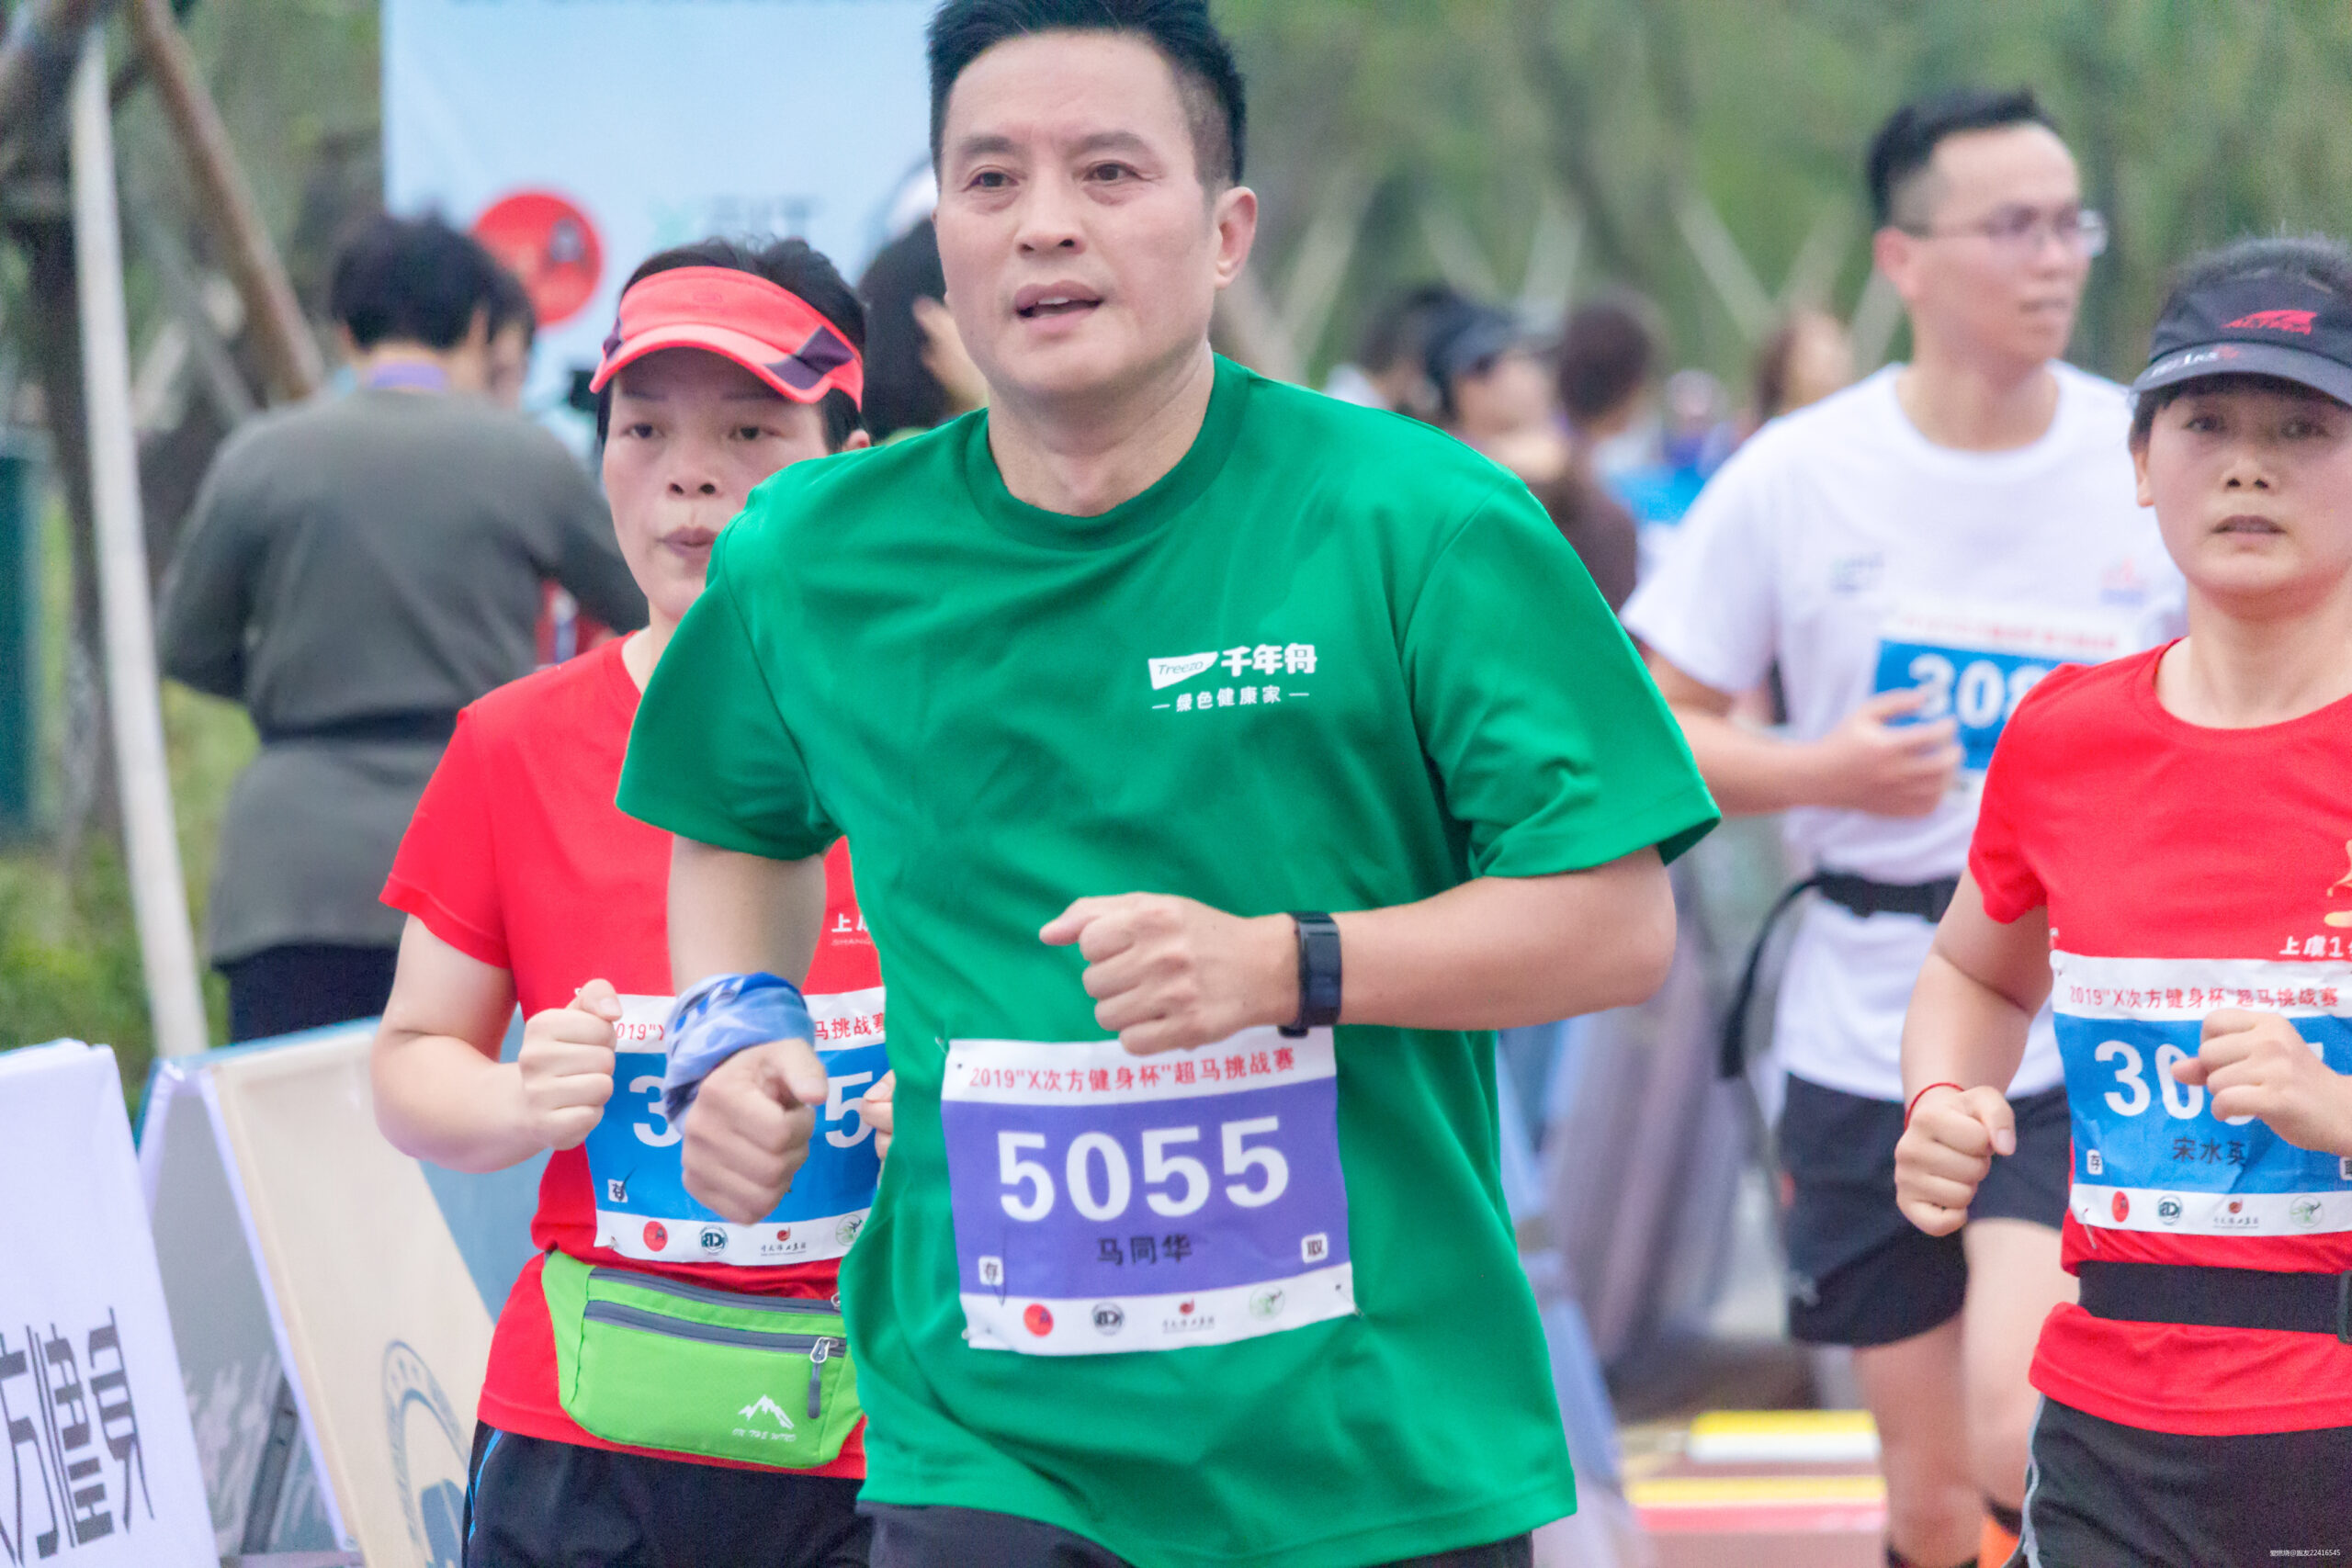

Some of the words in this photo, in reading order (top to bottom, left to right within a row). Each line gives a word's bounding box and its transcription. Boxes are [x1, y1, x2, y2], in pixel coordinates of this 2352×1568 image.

[1158, 660, 1204, 676] Treezo
[1221, 643, 1317, 677] 千年舟
[998, 1116, 1289, 1223] 5055
[1098, 1234, 1193, 1266] 马同华
[1306, 1239, 1324, 1257] 取
